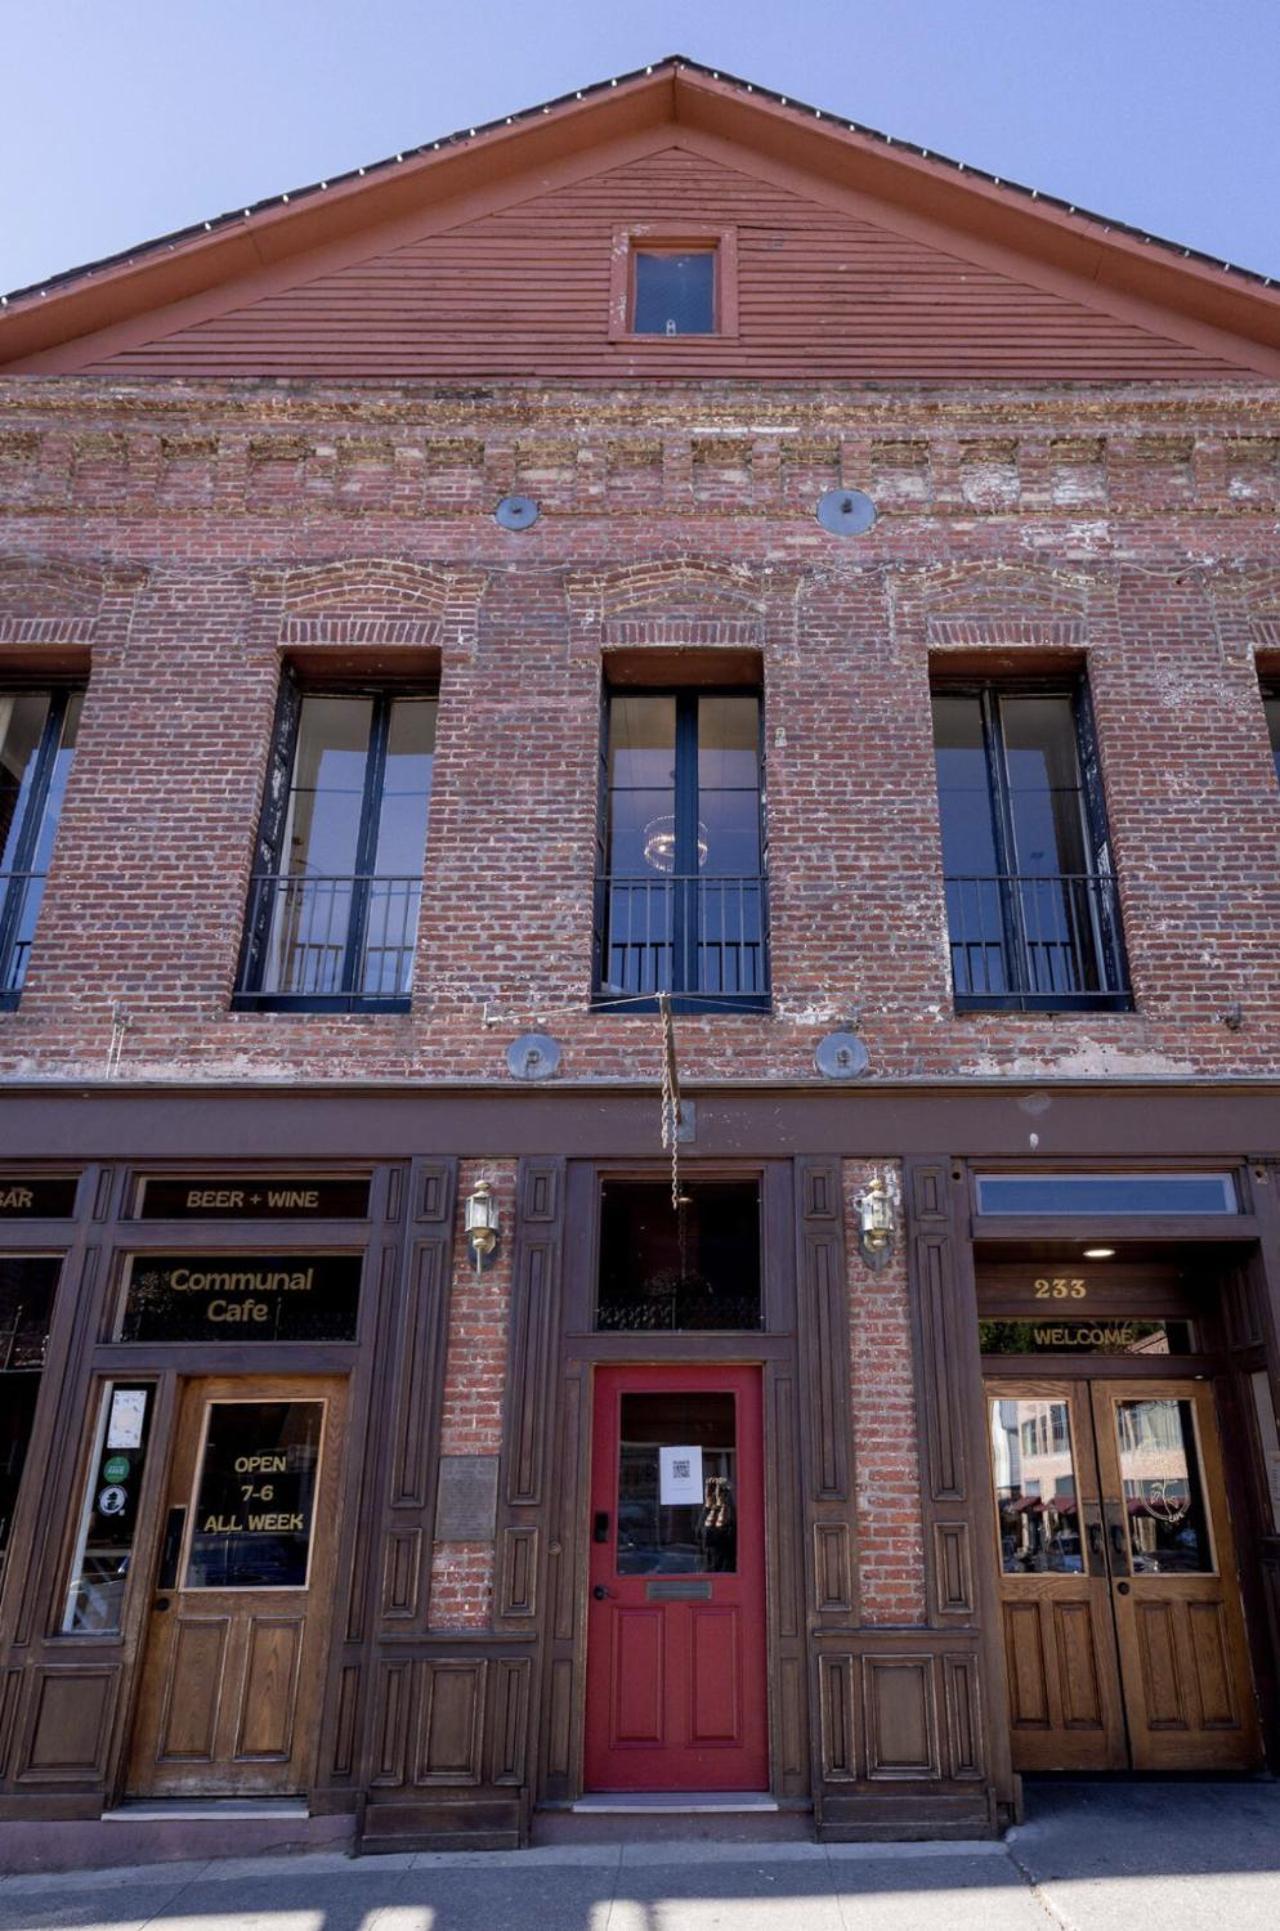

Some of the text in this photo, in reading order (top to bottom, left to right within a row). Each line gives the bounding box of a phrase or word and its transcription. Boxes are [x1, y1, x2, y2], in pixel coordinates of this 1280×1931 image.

[186, 1191, 243, 1207] BEER
[267, 1191, 319, 1207] WINE
[169, 1268, 313, 1291] Communal
[1034, 1279, 1086, 1298] 233
[207, 1299, 268, 1322] Cafe
[1034, 1328, 1134, 1345] WELCOME
[234, 1456, 286, 1472] OPEN
[240, 1485, 274, 1501] 7-6
[204, 1514, 304, 1532] ALL WEEK
